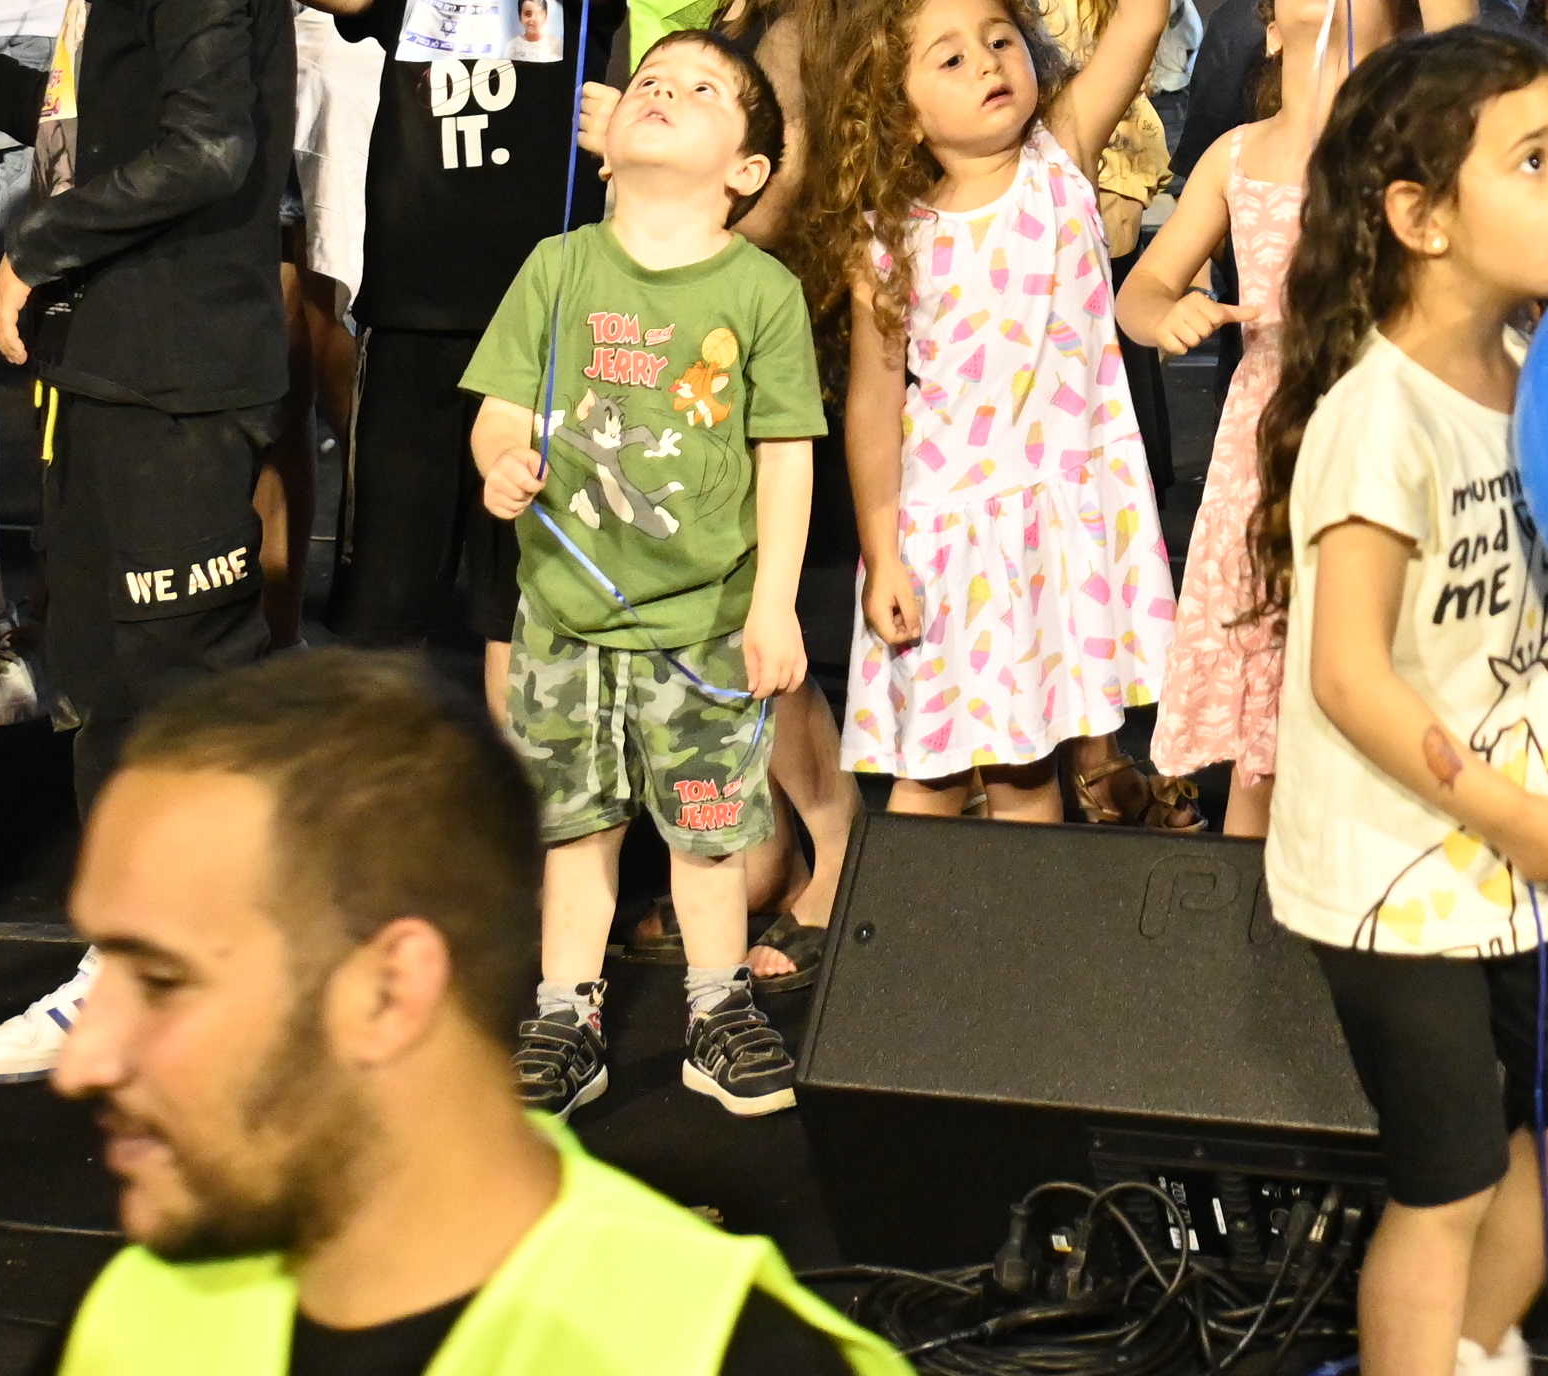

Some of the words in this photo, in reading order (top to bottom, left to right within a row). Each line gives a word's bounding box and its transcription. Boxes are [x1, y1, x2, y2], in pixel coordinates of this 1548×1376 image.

[430, 58, 517, 117] DO
[441, 114, 510, 169] IT.
[585, 311, 641, 345] TOM
[643, 323, 676, 347] and
[582, 347, 669, 388] JERRY
[1448, 507, 1509, 571] and
[125, 568, 178, 605] WE
[188, 546, 249, 596] ARE
[673, 777, 720, 803] TOM
[675, 799, 744, 830] JERRY
